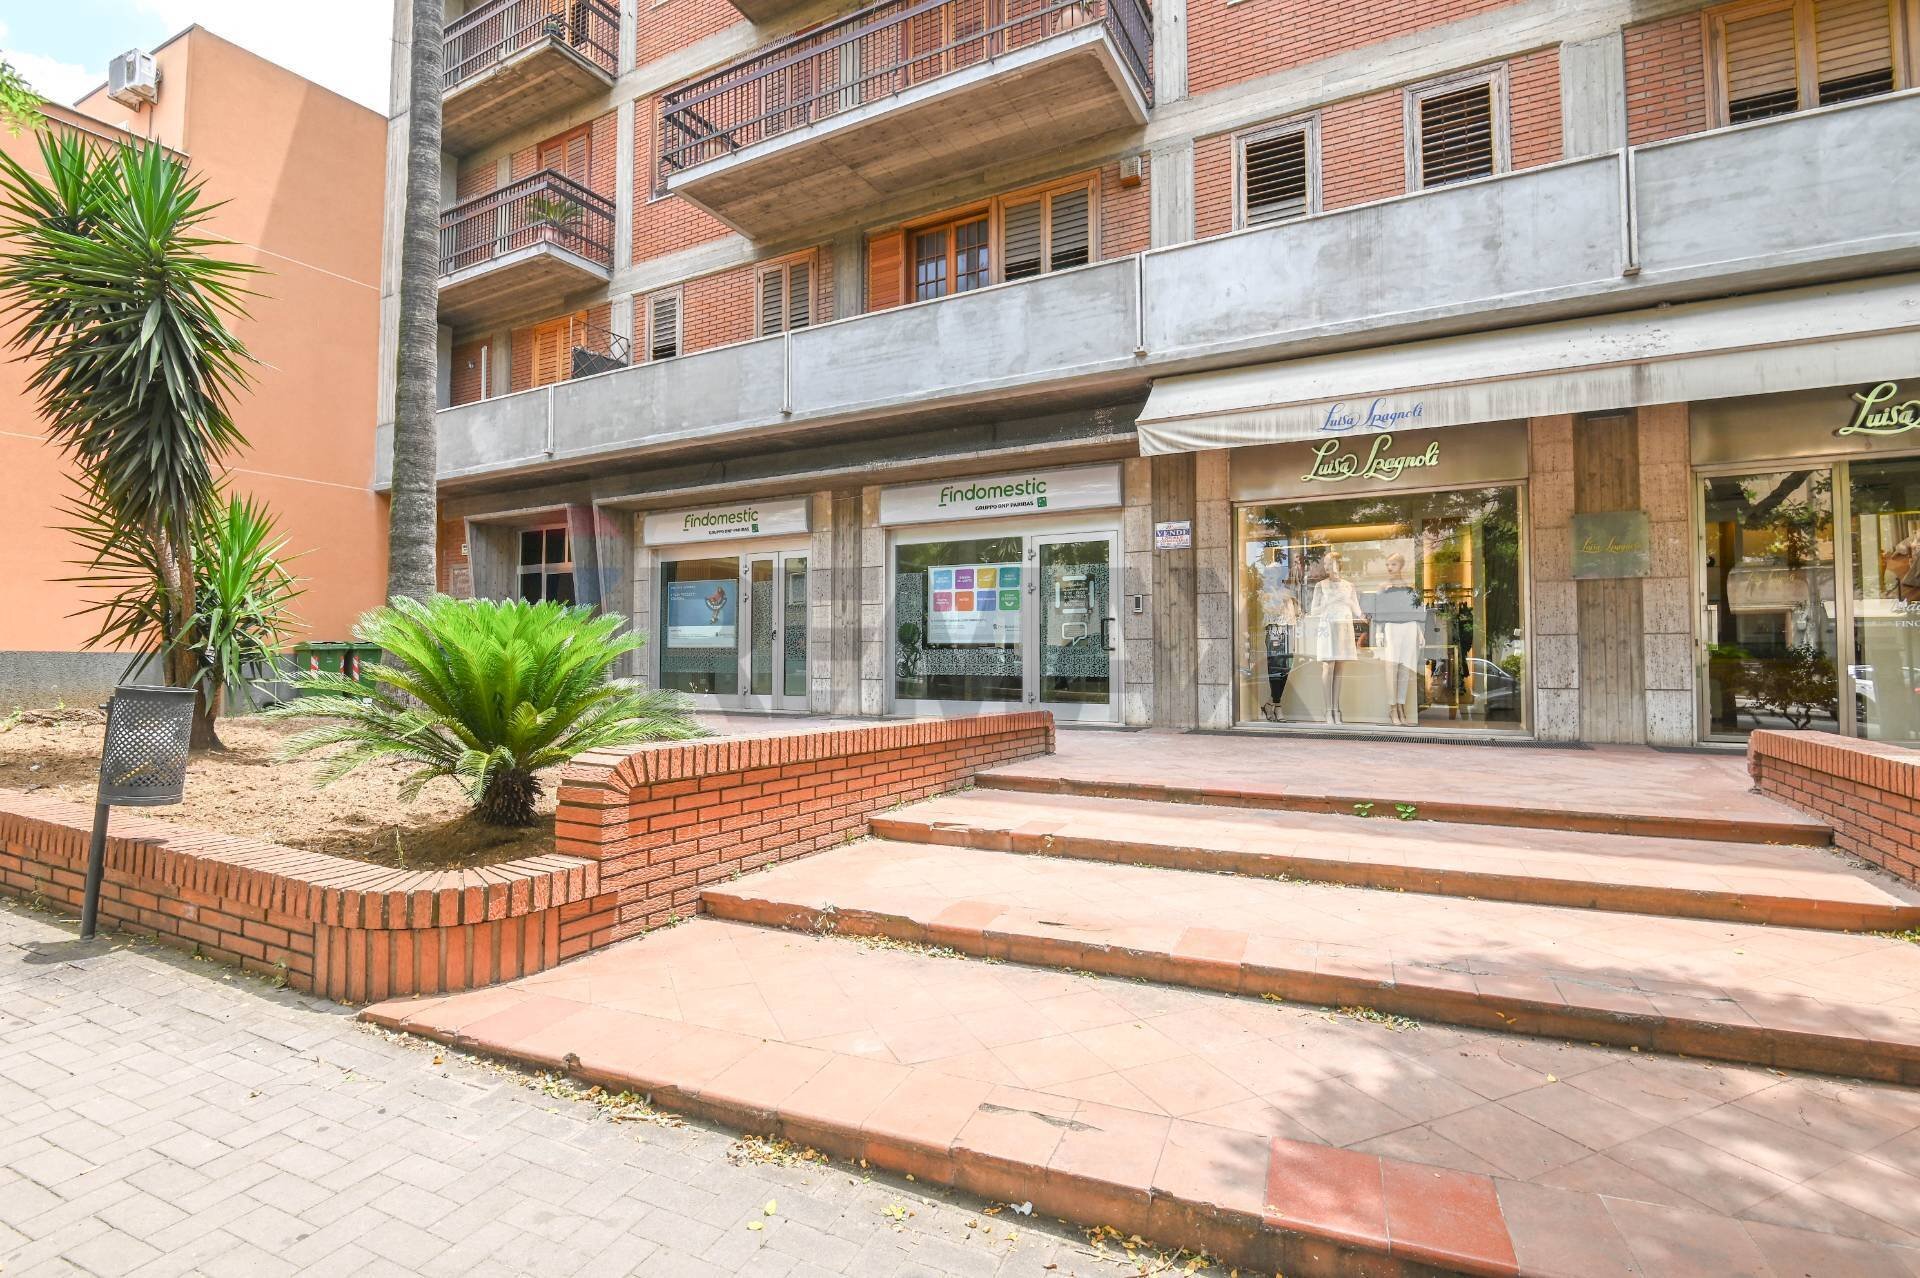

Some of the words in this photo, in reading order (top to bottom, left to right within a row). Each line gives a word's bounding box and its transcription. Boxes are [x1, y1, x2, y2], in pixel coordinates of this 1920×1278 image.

[1317, 402, 1361, 431] Luisa
[1360, 398, 1424, 429] Spagnoli
[1838, 382, 1920, 435] Luisa
[1300, 439, 1358, 482] Luisa
[1356, 434, 1440, 482] Spagnoli
[1010, 500, 1034, 508] PARIBAS
[1156, 529, 1189, 537] VENDE
